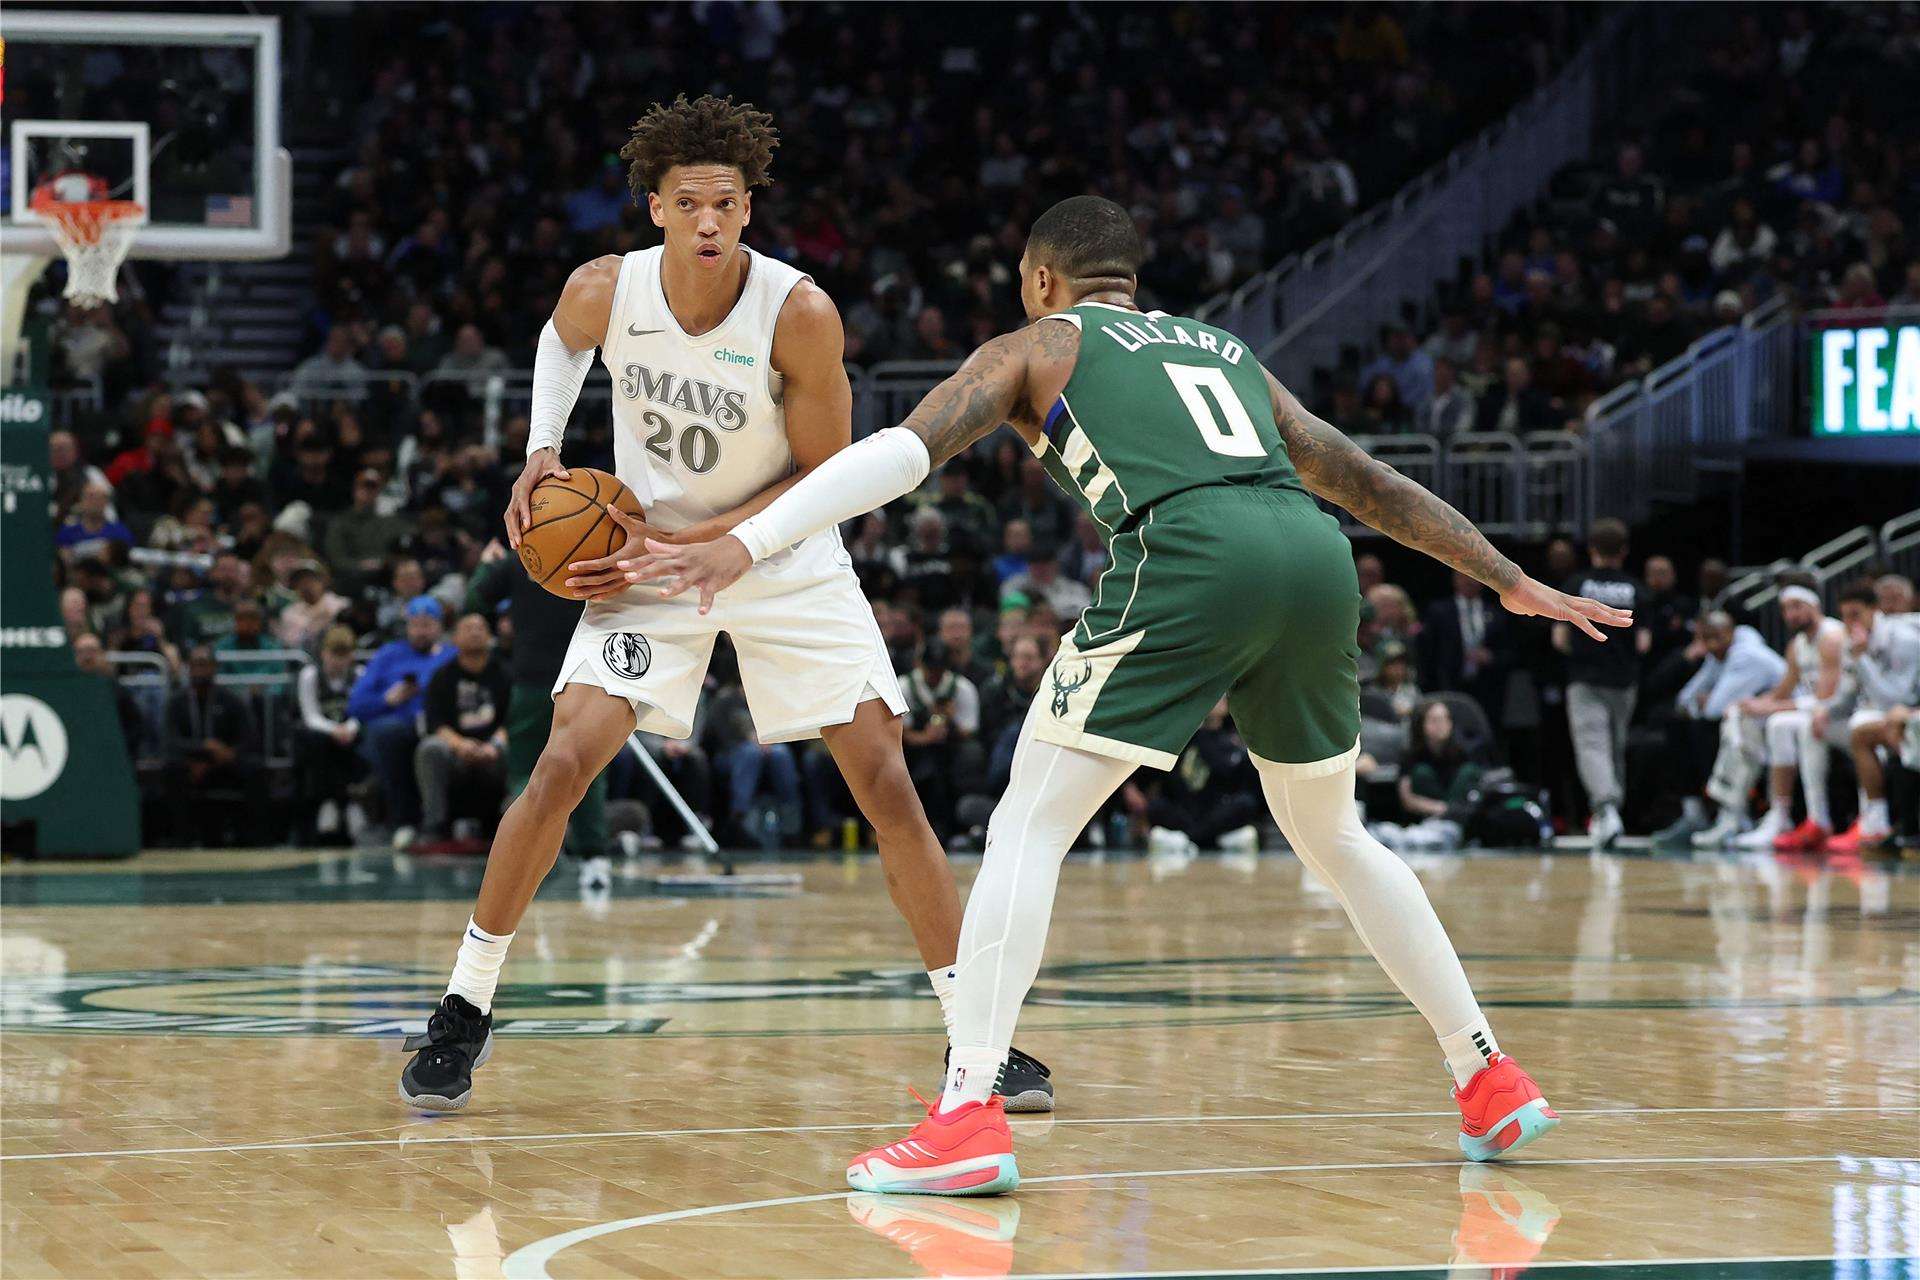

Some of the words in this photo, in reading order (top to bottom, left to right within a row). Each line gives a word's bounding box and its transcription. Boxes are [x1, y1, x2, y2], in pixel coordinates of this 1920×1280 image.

[714, 348, 755, 367] chime
[1101, 321, 1243, 365] LILLARD
[620, 363, 748, 433] MAVS
[1162, 362, 1268, 457] 0
[1823, 326, 1920, 432] FEA
[642, 410, 721, 474] 20
